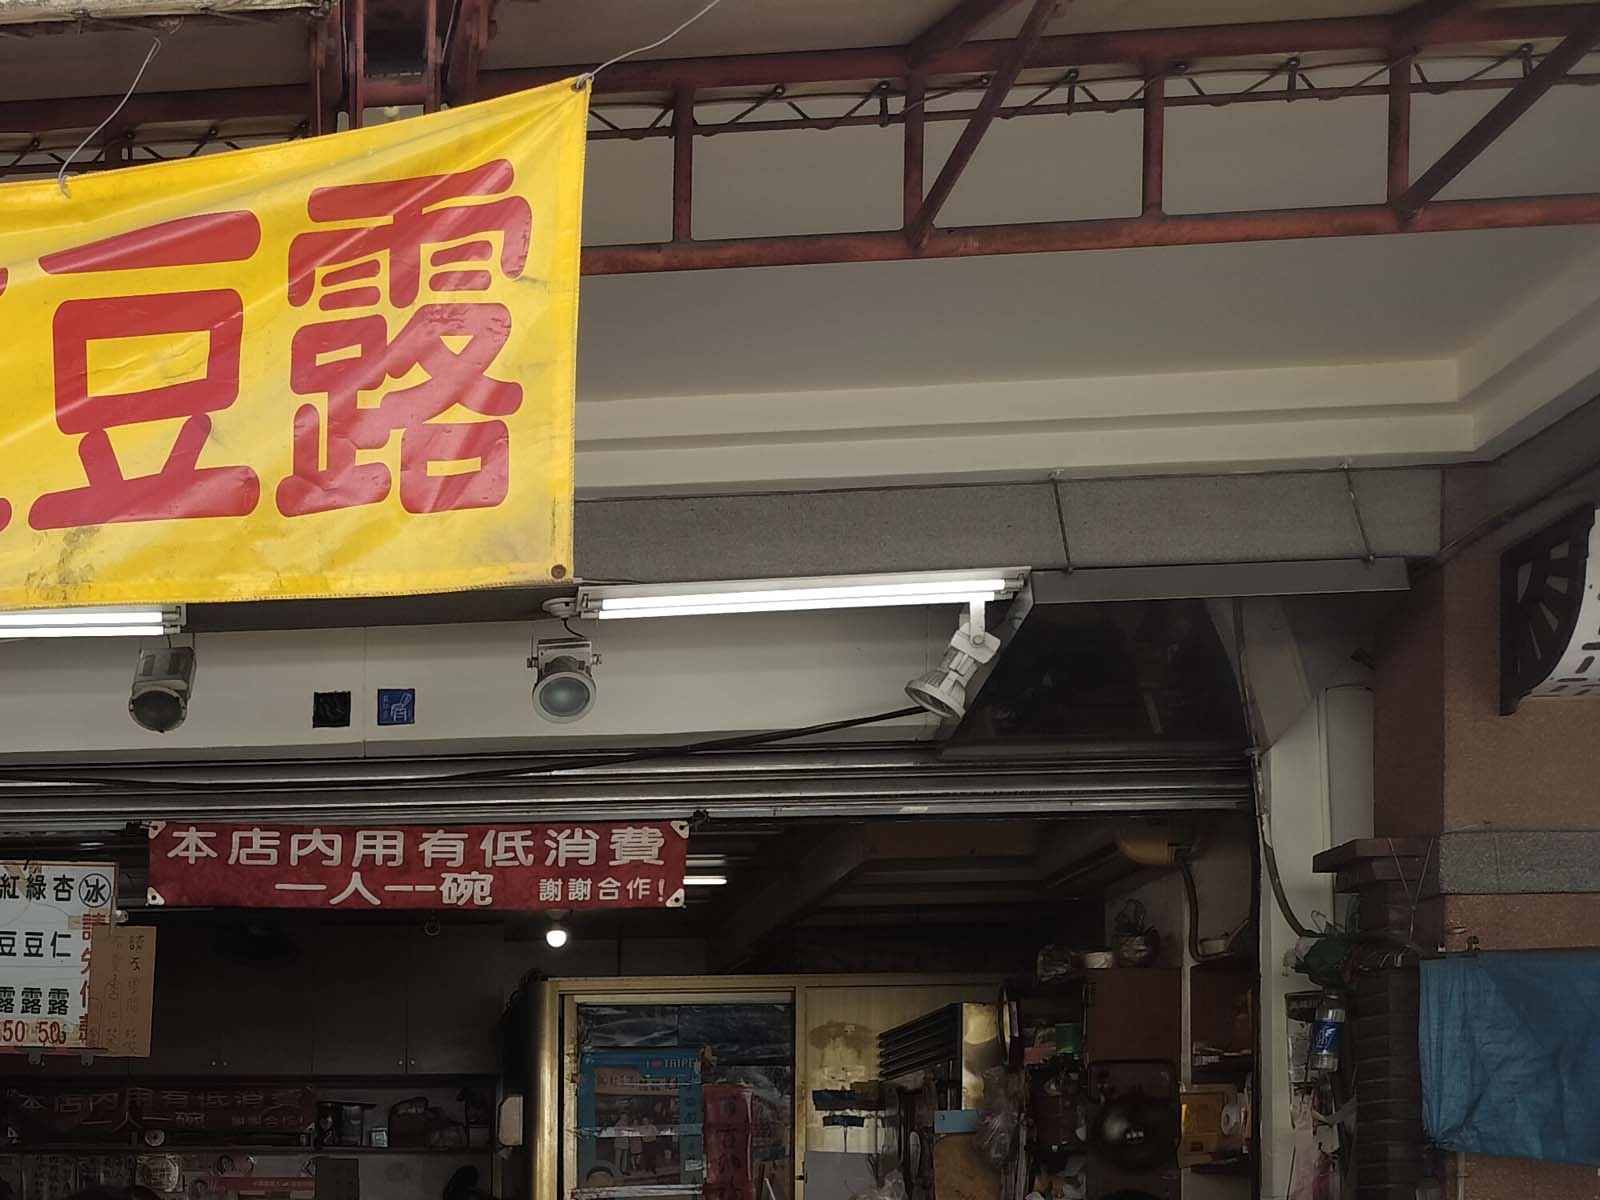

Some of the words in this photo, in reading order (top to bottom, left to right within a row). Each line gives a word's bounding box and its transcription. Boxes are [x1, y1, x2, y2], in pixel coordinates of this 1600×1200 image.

[166, 827, 666, 867] 本店內用有低消費
[84, 877, 107, 904] 冰
[274, 871, 494, 906] 一人一碗
[2, 1020, 25, 1042] 50
